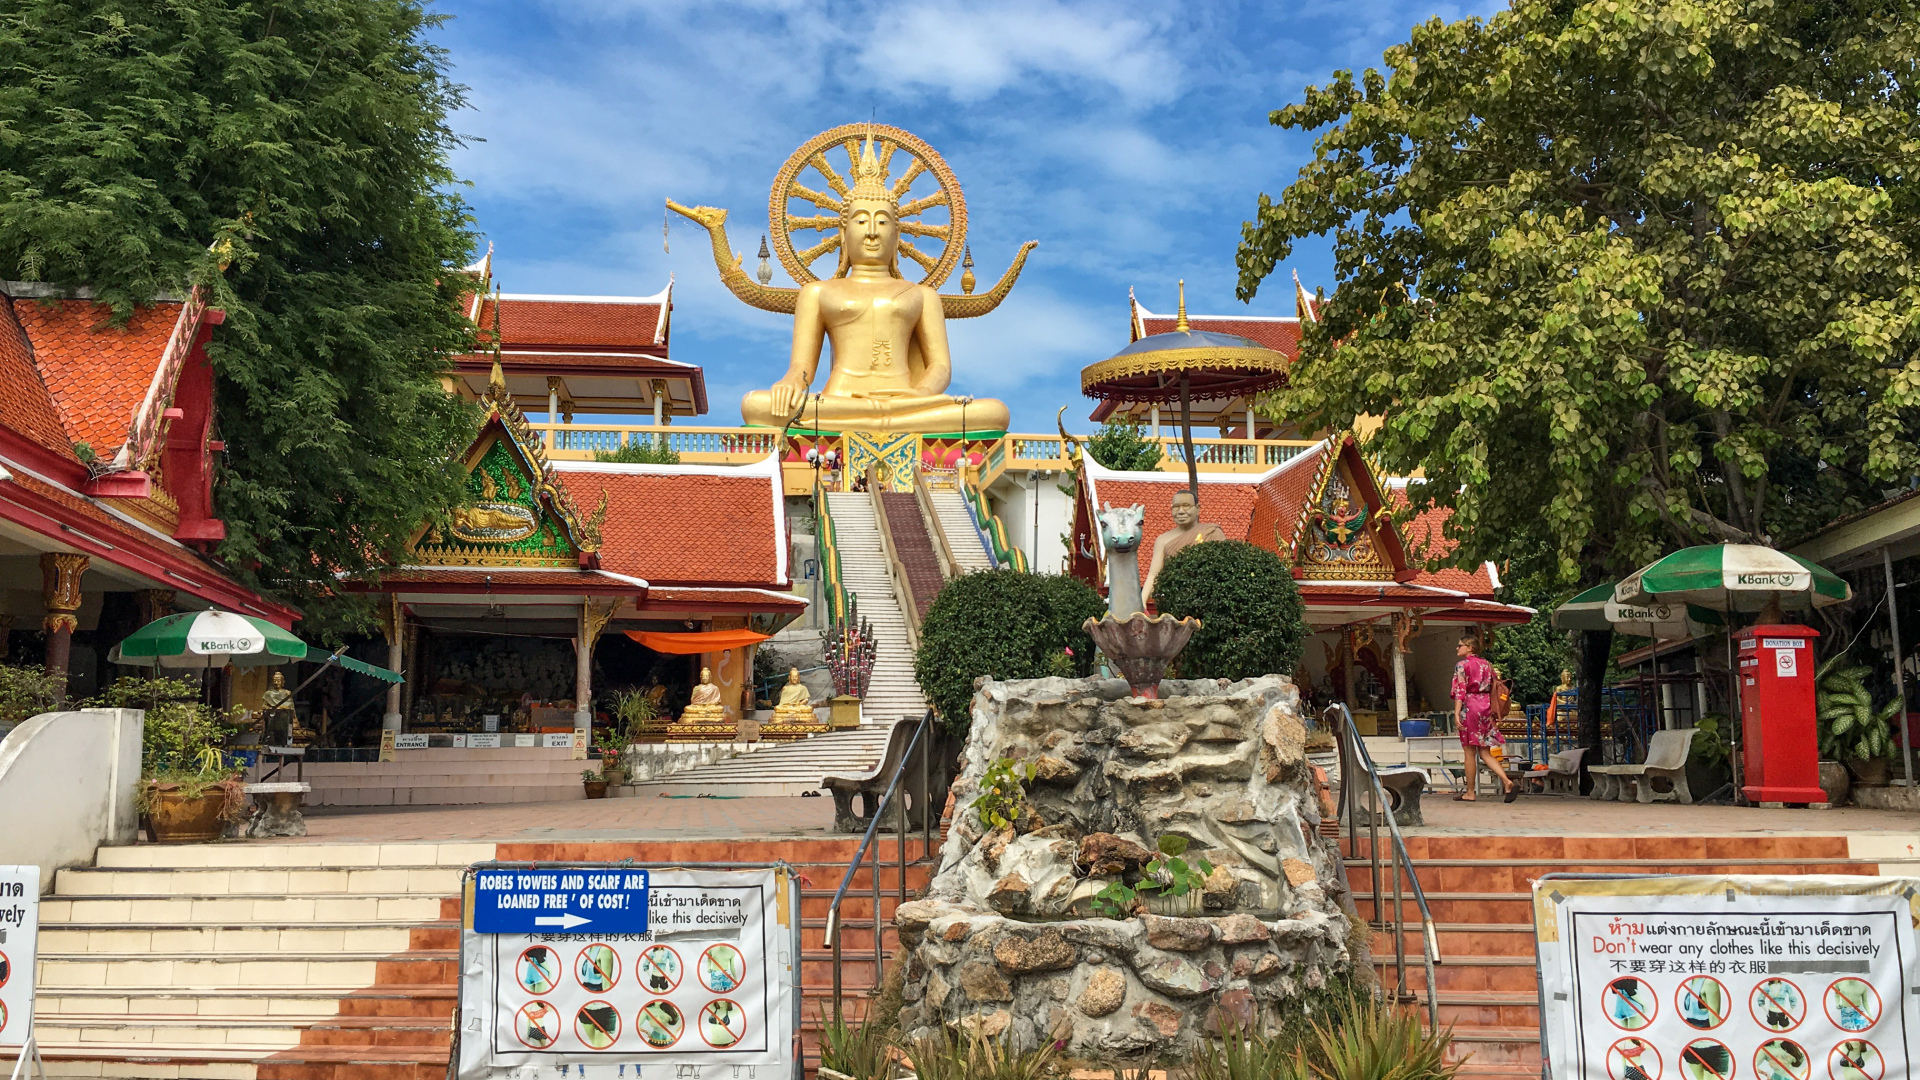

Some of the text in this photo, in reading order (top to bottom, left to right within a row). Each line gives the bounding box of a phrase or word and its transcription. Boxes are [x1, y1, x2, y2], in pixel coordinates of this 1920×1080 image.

[479, 875, 513, 890] ROBES
[560, 875, 584, 890] AND
[587, 875, 620, 890] SCARF
[623, 875, 645, 890] ARE
[497, 893, 540, 909] LOANED
[579, 893, 593, 909] OF
[649, 909, 749, 926] like this decisively
[1639, 944, 1673, 954] wear
[1678, 944, 1704, 958] any
[1710, 939, 1754, 954] clothes
[1759, 938, 1783, 955] like
[1788, 938, 1811, 955] this
[1816, 938, 1881, 959] decisively
[1609, 959, 1766, 974] 不要穿这样的衣服
